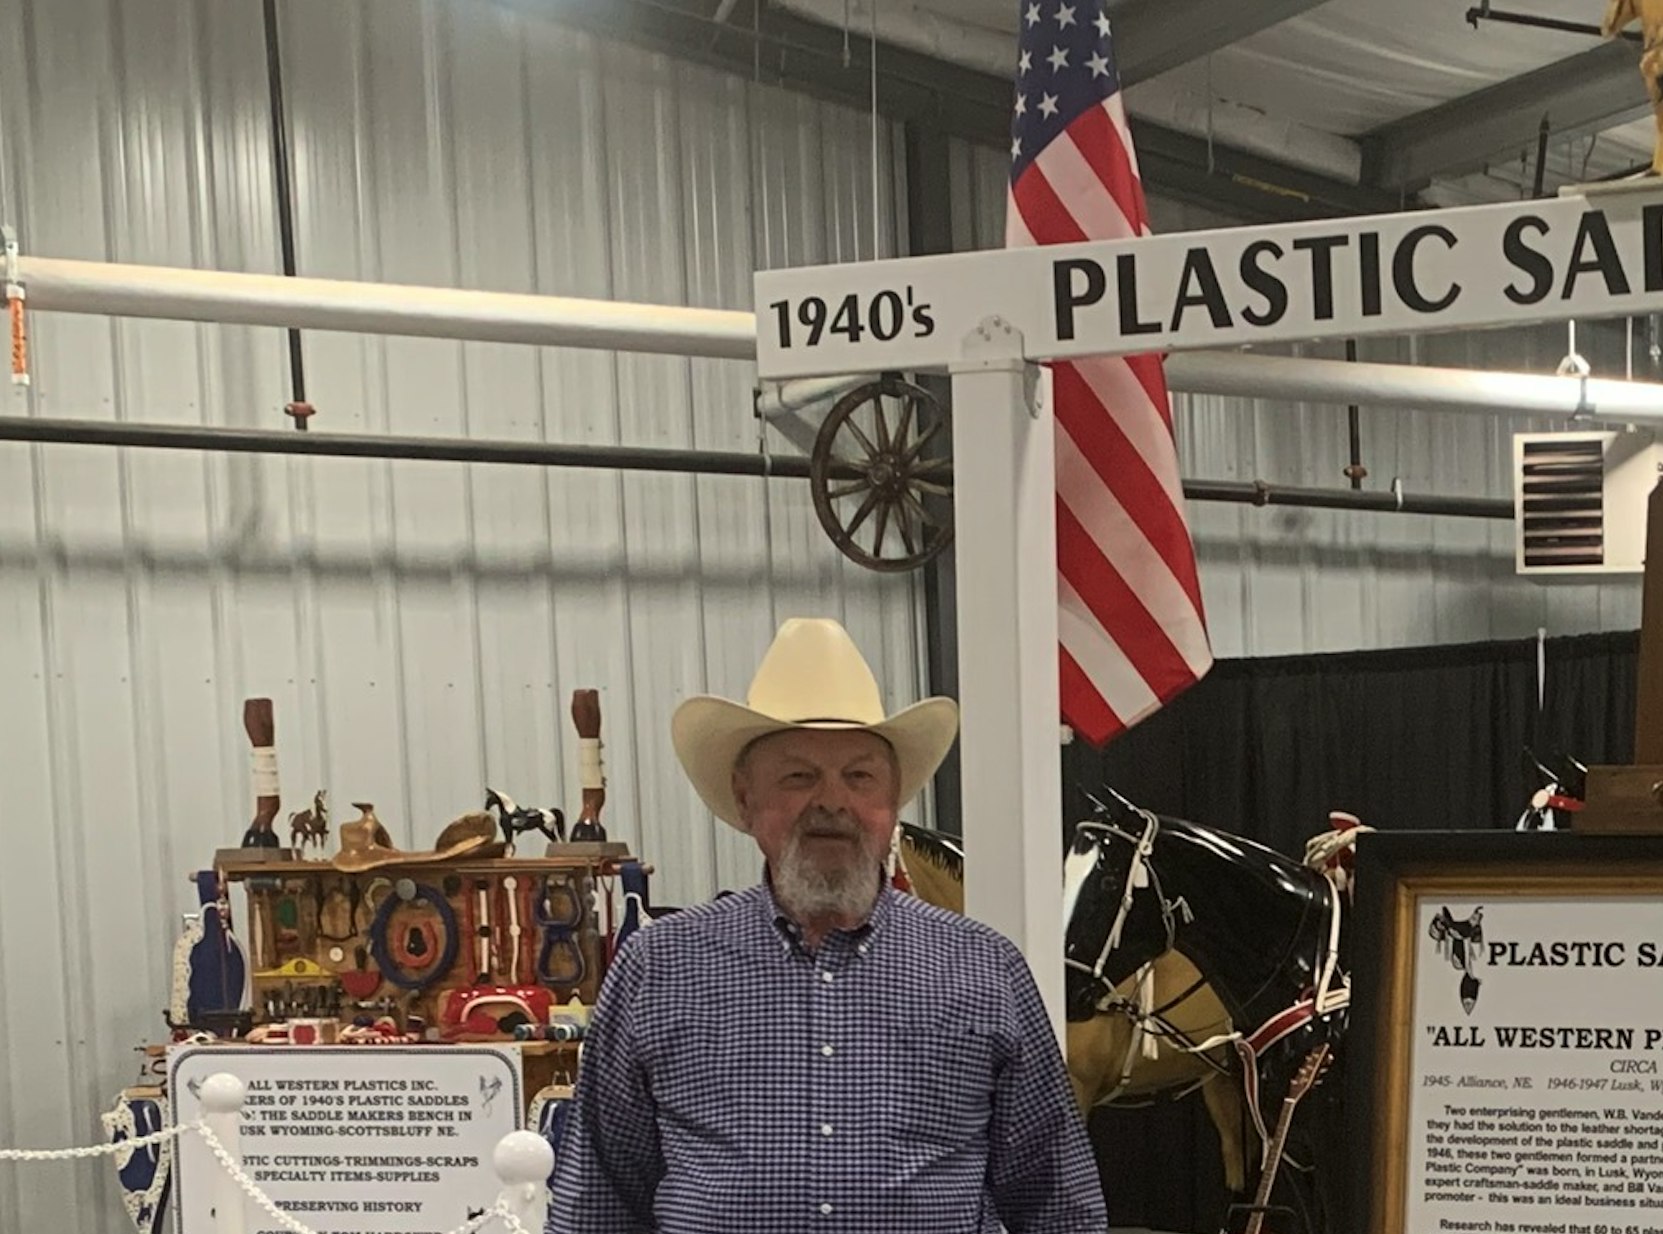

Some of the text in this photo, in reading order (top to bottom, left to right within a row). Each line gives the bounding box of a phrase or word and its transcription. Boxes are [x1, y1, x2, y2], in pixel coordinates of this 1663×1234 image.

[769, 286, 934, 349] 1940's
[1053, 225, 1462, 341] PLASTIC
[1486, 941, 1625, 968] PLASTIC
[1426, 1025, 1486, 1047] "ALL
[1493, 1026, 1635, 1050] WESTERN
[1609, 1058, 1658, 1075] CIRCA
[247, 1080, 438, 1091] ALL WESTERN PLASTICS INC.
[1546, 1076, 1609, 1091] 1946-1947
[1609, 1078, 1645, 1093] Lusk,
[244, 1095, 469, 1106] ERS OF 1940'S PLASTIC SADDLES
[261, 1110, 287, 1121] THE
[291, 1110, 343, 1121] SADDLE
[347, 1110, 404, 1121] MAKERS
[408, 1110, 454, 1121] BENCH
[458, 1110, 472, 1121] IN
[1443, 1104, 1467, 1117] Two
[1468, 1106, 1536, 1120] enterprising
[240, 1125, 459, 1136] USK WYOMING-SCOTTSBLUFF NE.
[242, 1156, 479, 1167] STIC CUTTINGS-TRIMMINGS-SCRAPS
[255, 1171, 440, 1182] SPECIALTY ITEMS-SUPPLIES
[363, 1201, 422, 1212] HISTORY
[1439, 1217, 1492, 1232] Research
[1493, 1220, 1516, 1233] has
[1517, 1222, 1567, 1234] revealed
